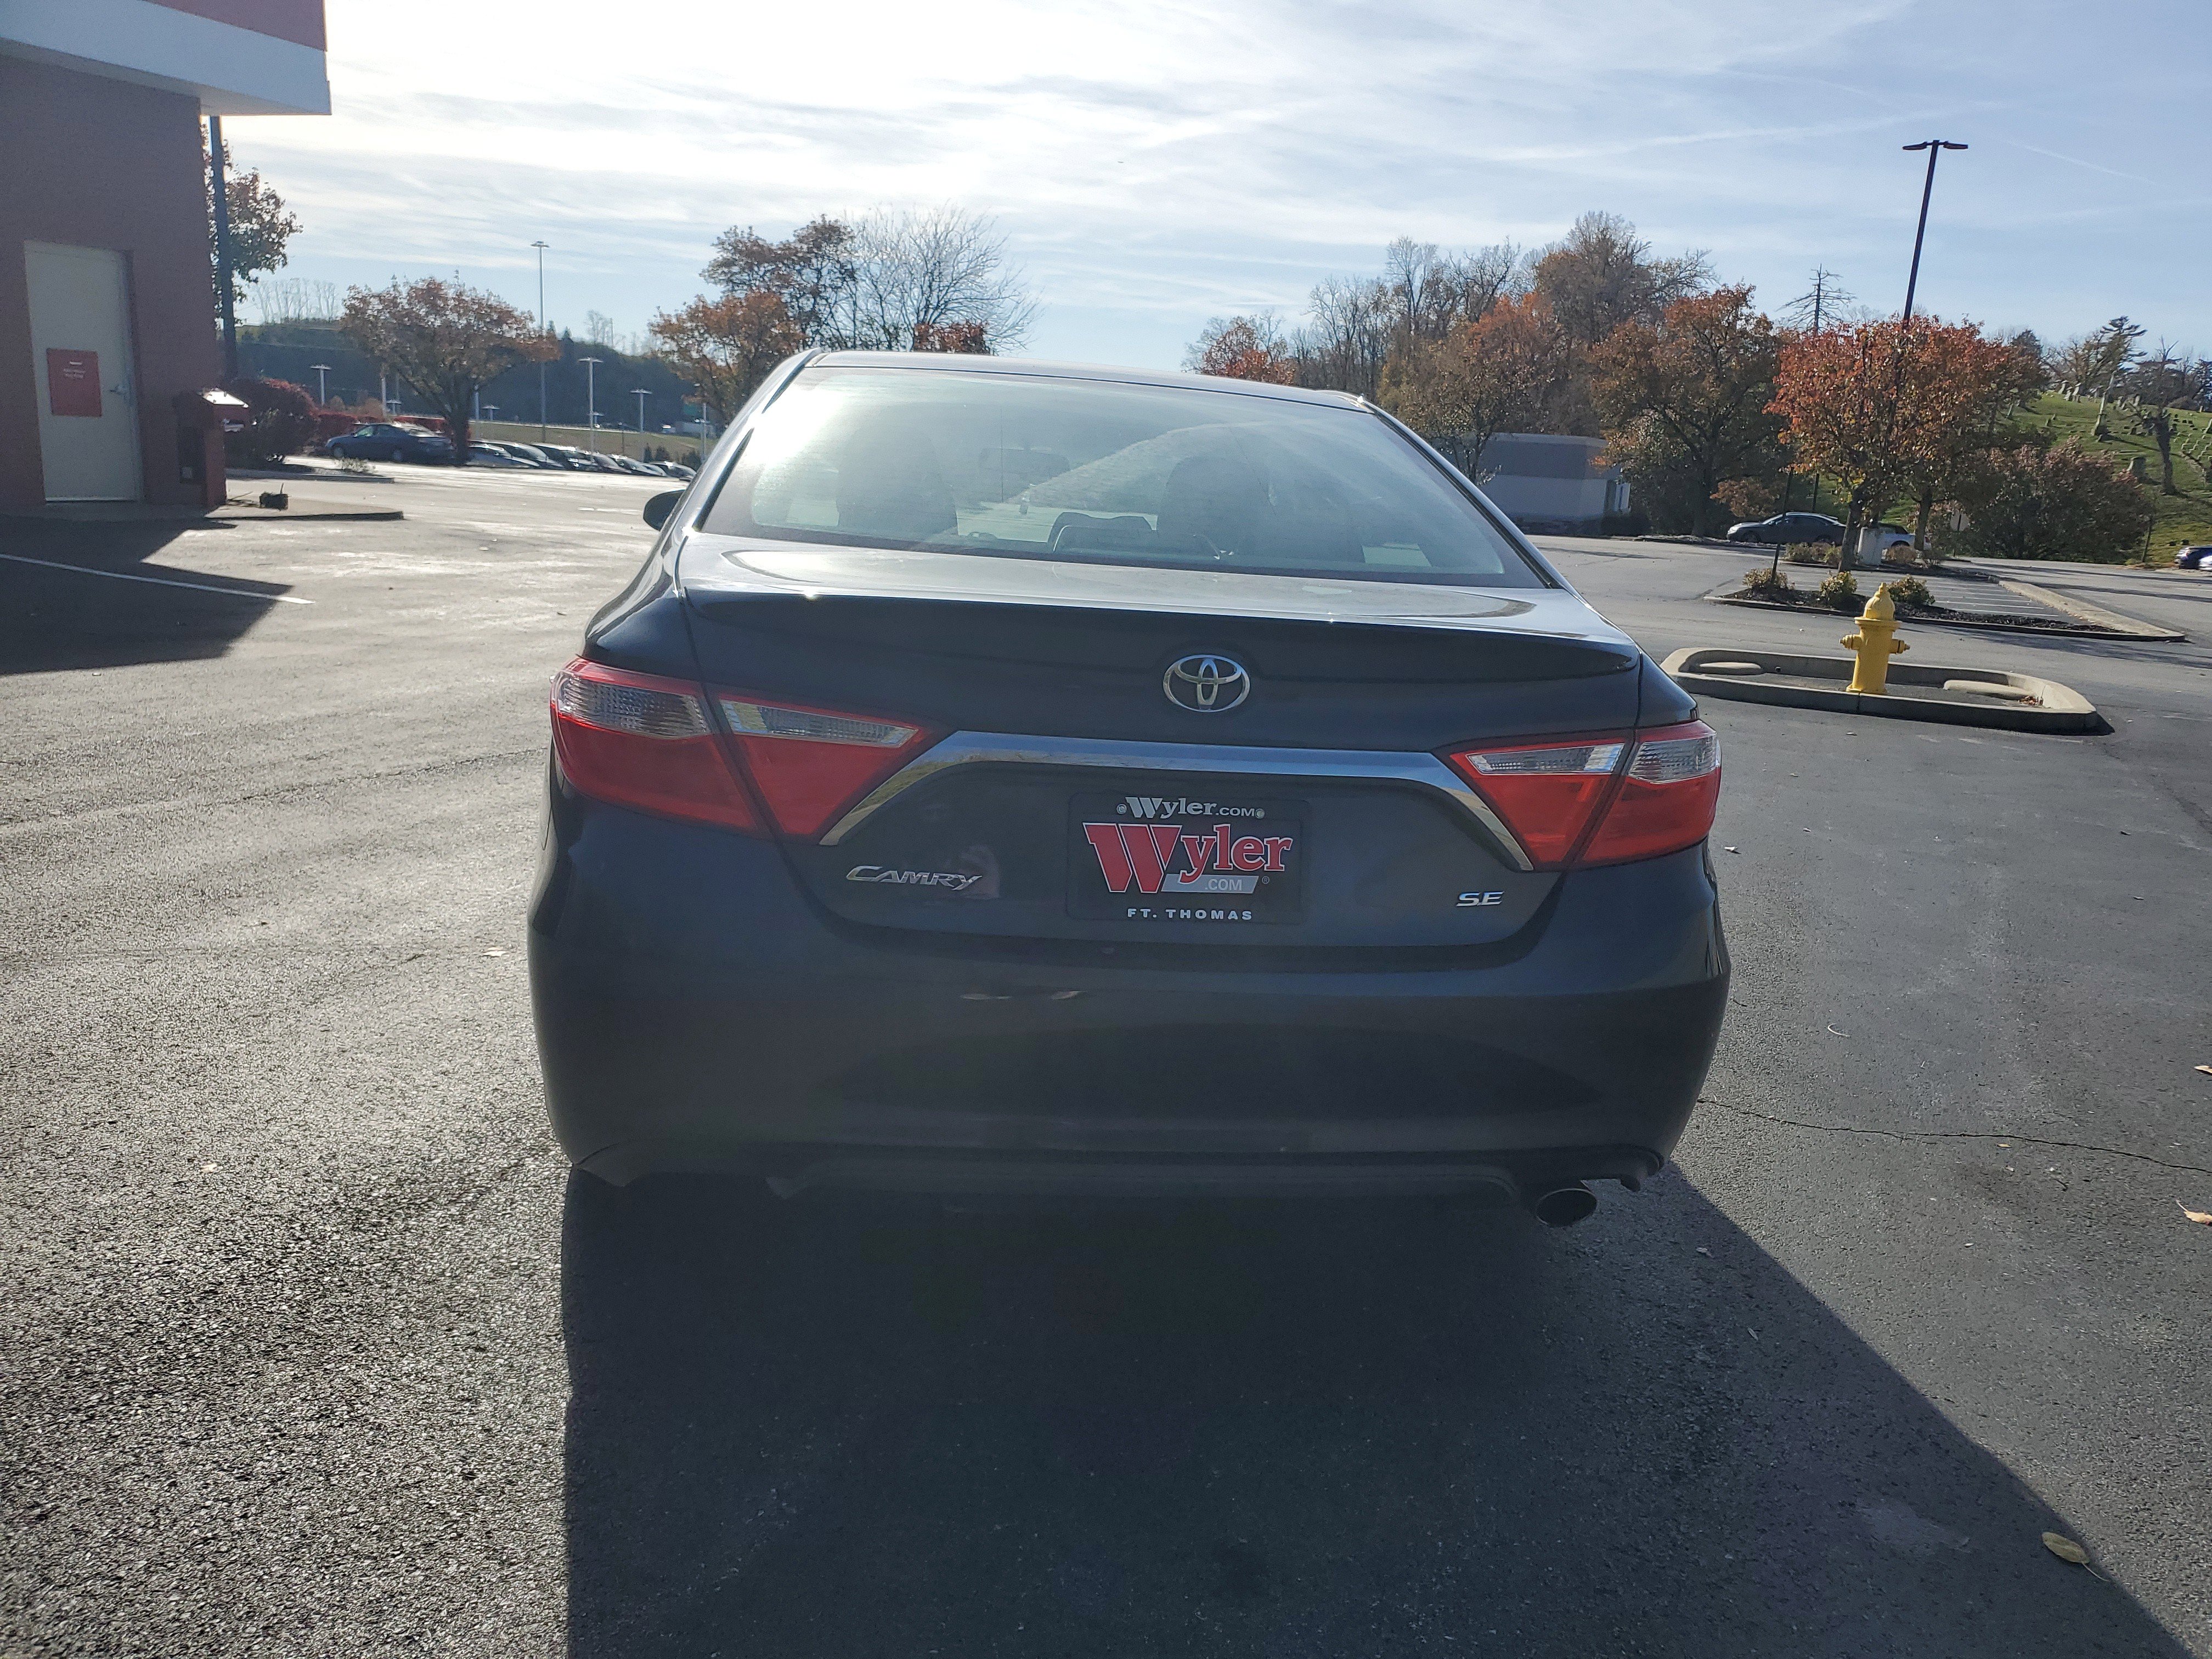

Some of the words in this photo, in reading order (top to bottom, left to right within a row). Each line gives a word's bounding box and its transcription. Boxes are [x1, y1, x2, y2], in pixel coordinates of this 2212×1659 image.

[1082, 822, 1293, 894] Wyler
[846, 865, 983, 890] CAMRY
[1205, 878, 1242, 891] .COM
[1455, 891, 1505, 907] SE
[1127, 909, 1157, 918] FT.
[1165, 909, 1252, 920] THOMAS
